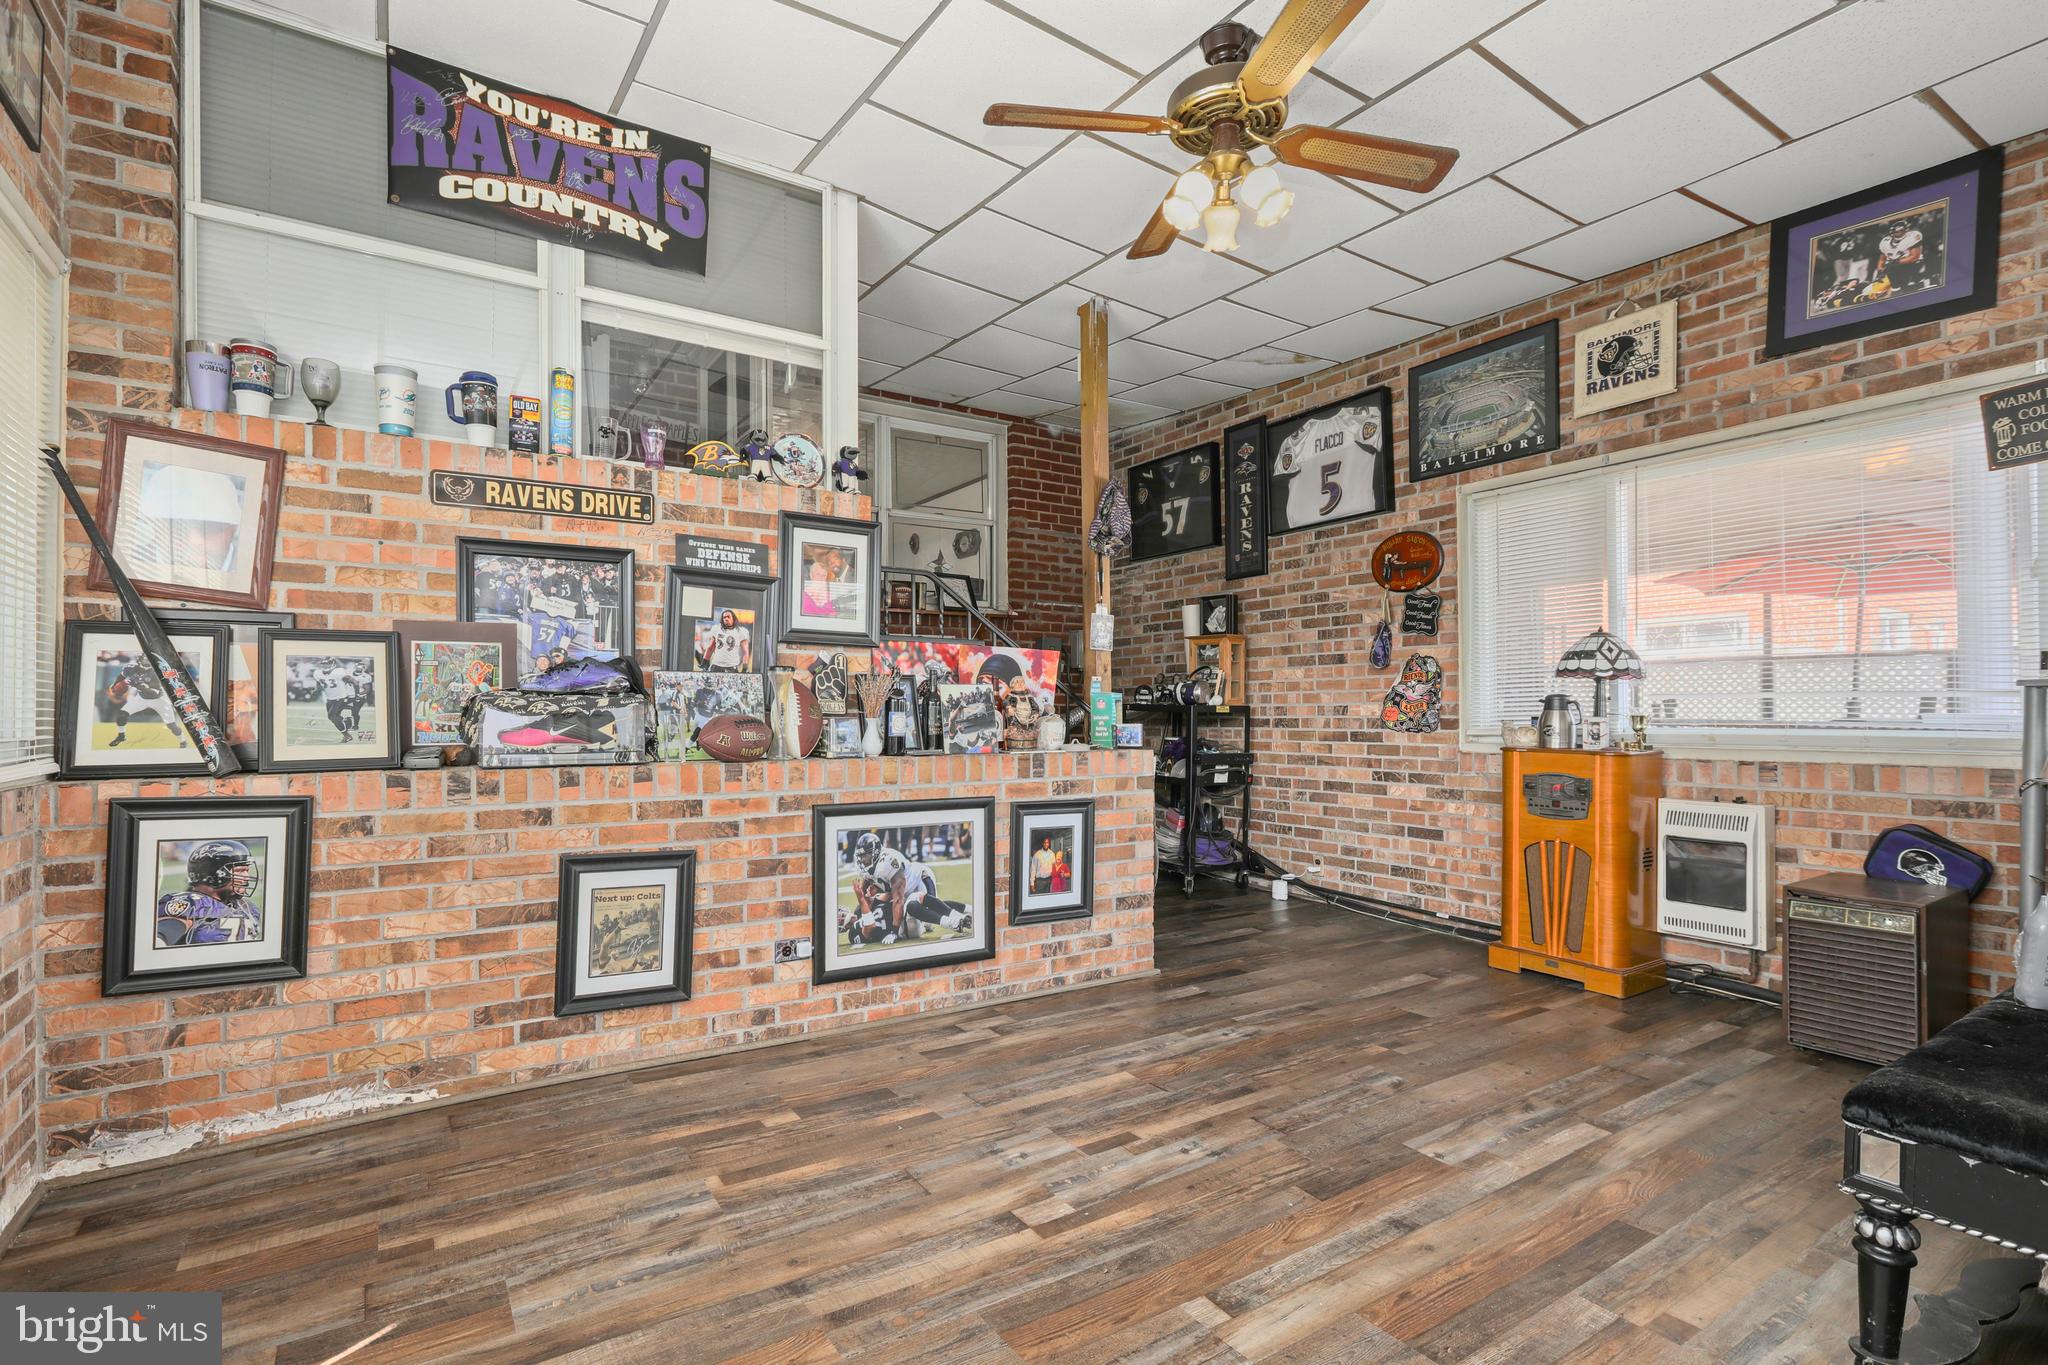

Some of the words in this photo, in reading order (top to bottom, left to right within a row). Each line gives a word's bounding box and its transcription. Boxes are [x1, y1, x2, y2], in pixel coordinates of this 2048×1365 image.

[459, 72, 601, 144] YOU'RE
[612, 128, 649, 151] IN
[390, 65, 706, 239] RAVENS
[439, 175, 670, 252] COUNTRY
[1587, 320, 1661, 349] BALTIMORE
[1586, 364, 1660, 395] RAVENS
[513, 400, 525, 410] OLD
[526, 402, 538, 411] BAY
[1993, 389, 2042, 410] WARM
[1314, 431, 1344, 454] FLACCO
[1420, 434, 1545, 473] BALTIMORE
[1996, 441, 2043, 460] COME
[485, 480, 575, 512] RAVENS
[581, 491, 642, 519] DRIVE
[1320, 460, 1343, 516] 5
[1161, 496, 1191, 536] 57
[1239, 482, 1253, 552] RAVENS
[685, 557, 705, 567] WINS
[707, 560, 762, 574] CHAMPIONSHIPS
[697, 547, 750, 564] DEFENSE
[538, 627, 556, 643] 57
[740, 730, 765, 741] Wilson
[595, 895, 618, 903] Next
[620, 894, 635, 902] up:
[637, 892, 661, 900] Colts
